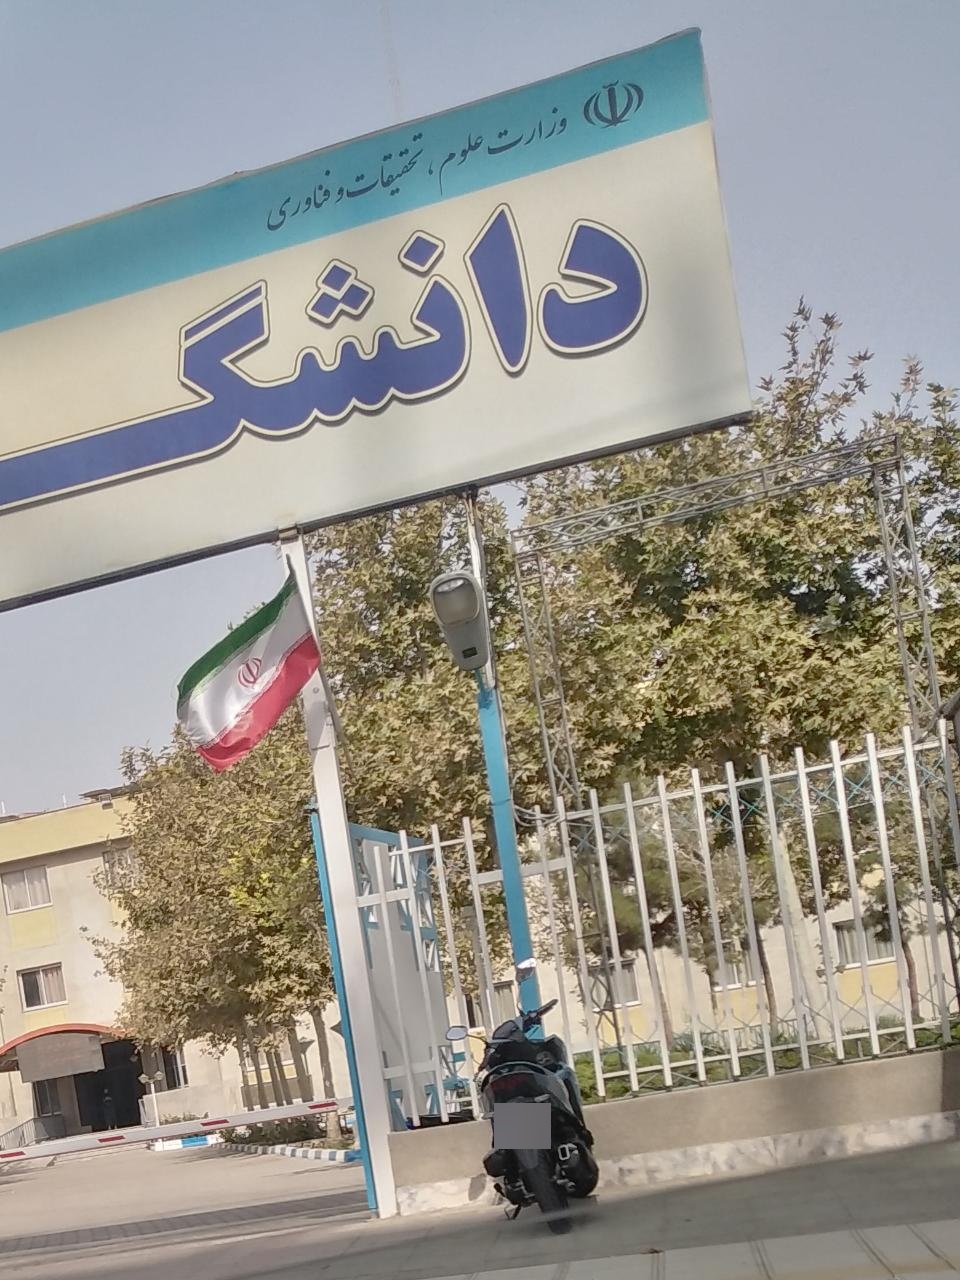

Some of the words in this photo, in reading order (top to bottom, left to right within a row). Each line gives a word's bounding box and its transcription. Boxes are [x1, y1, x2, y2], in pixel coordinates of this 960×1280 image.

[486, 107, 569, 155] وزارت
[345, 132, 424, 197] تحقیقات
[266, 169, 331, 232] فناوری
